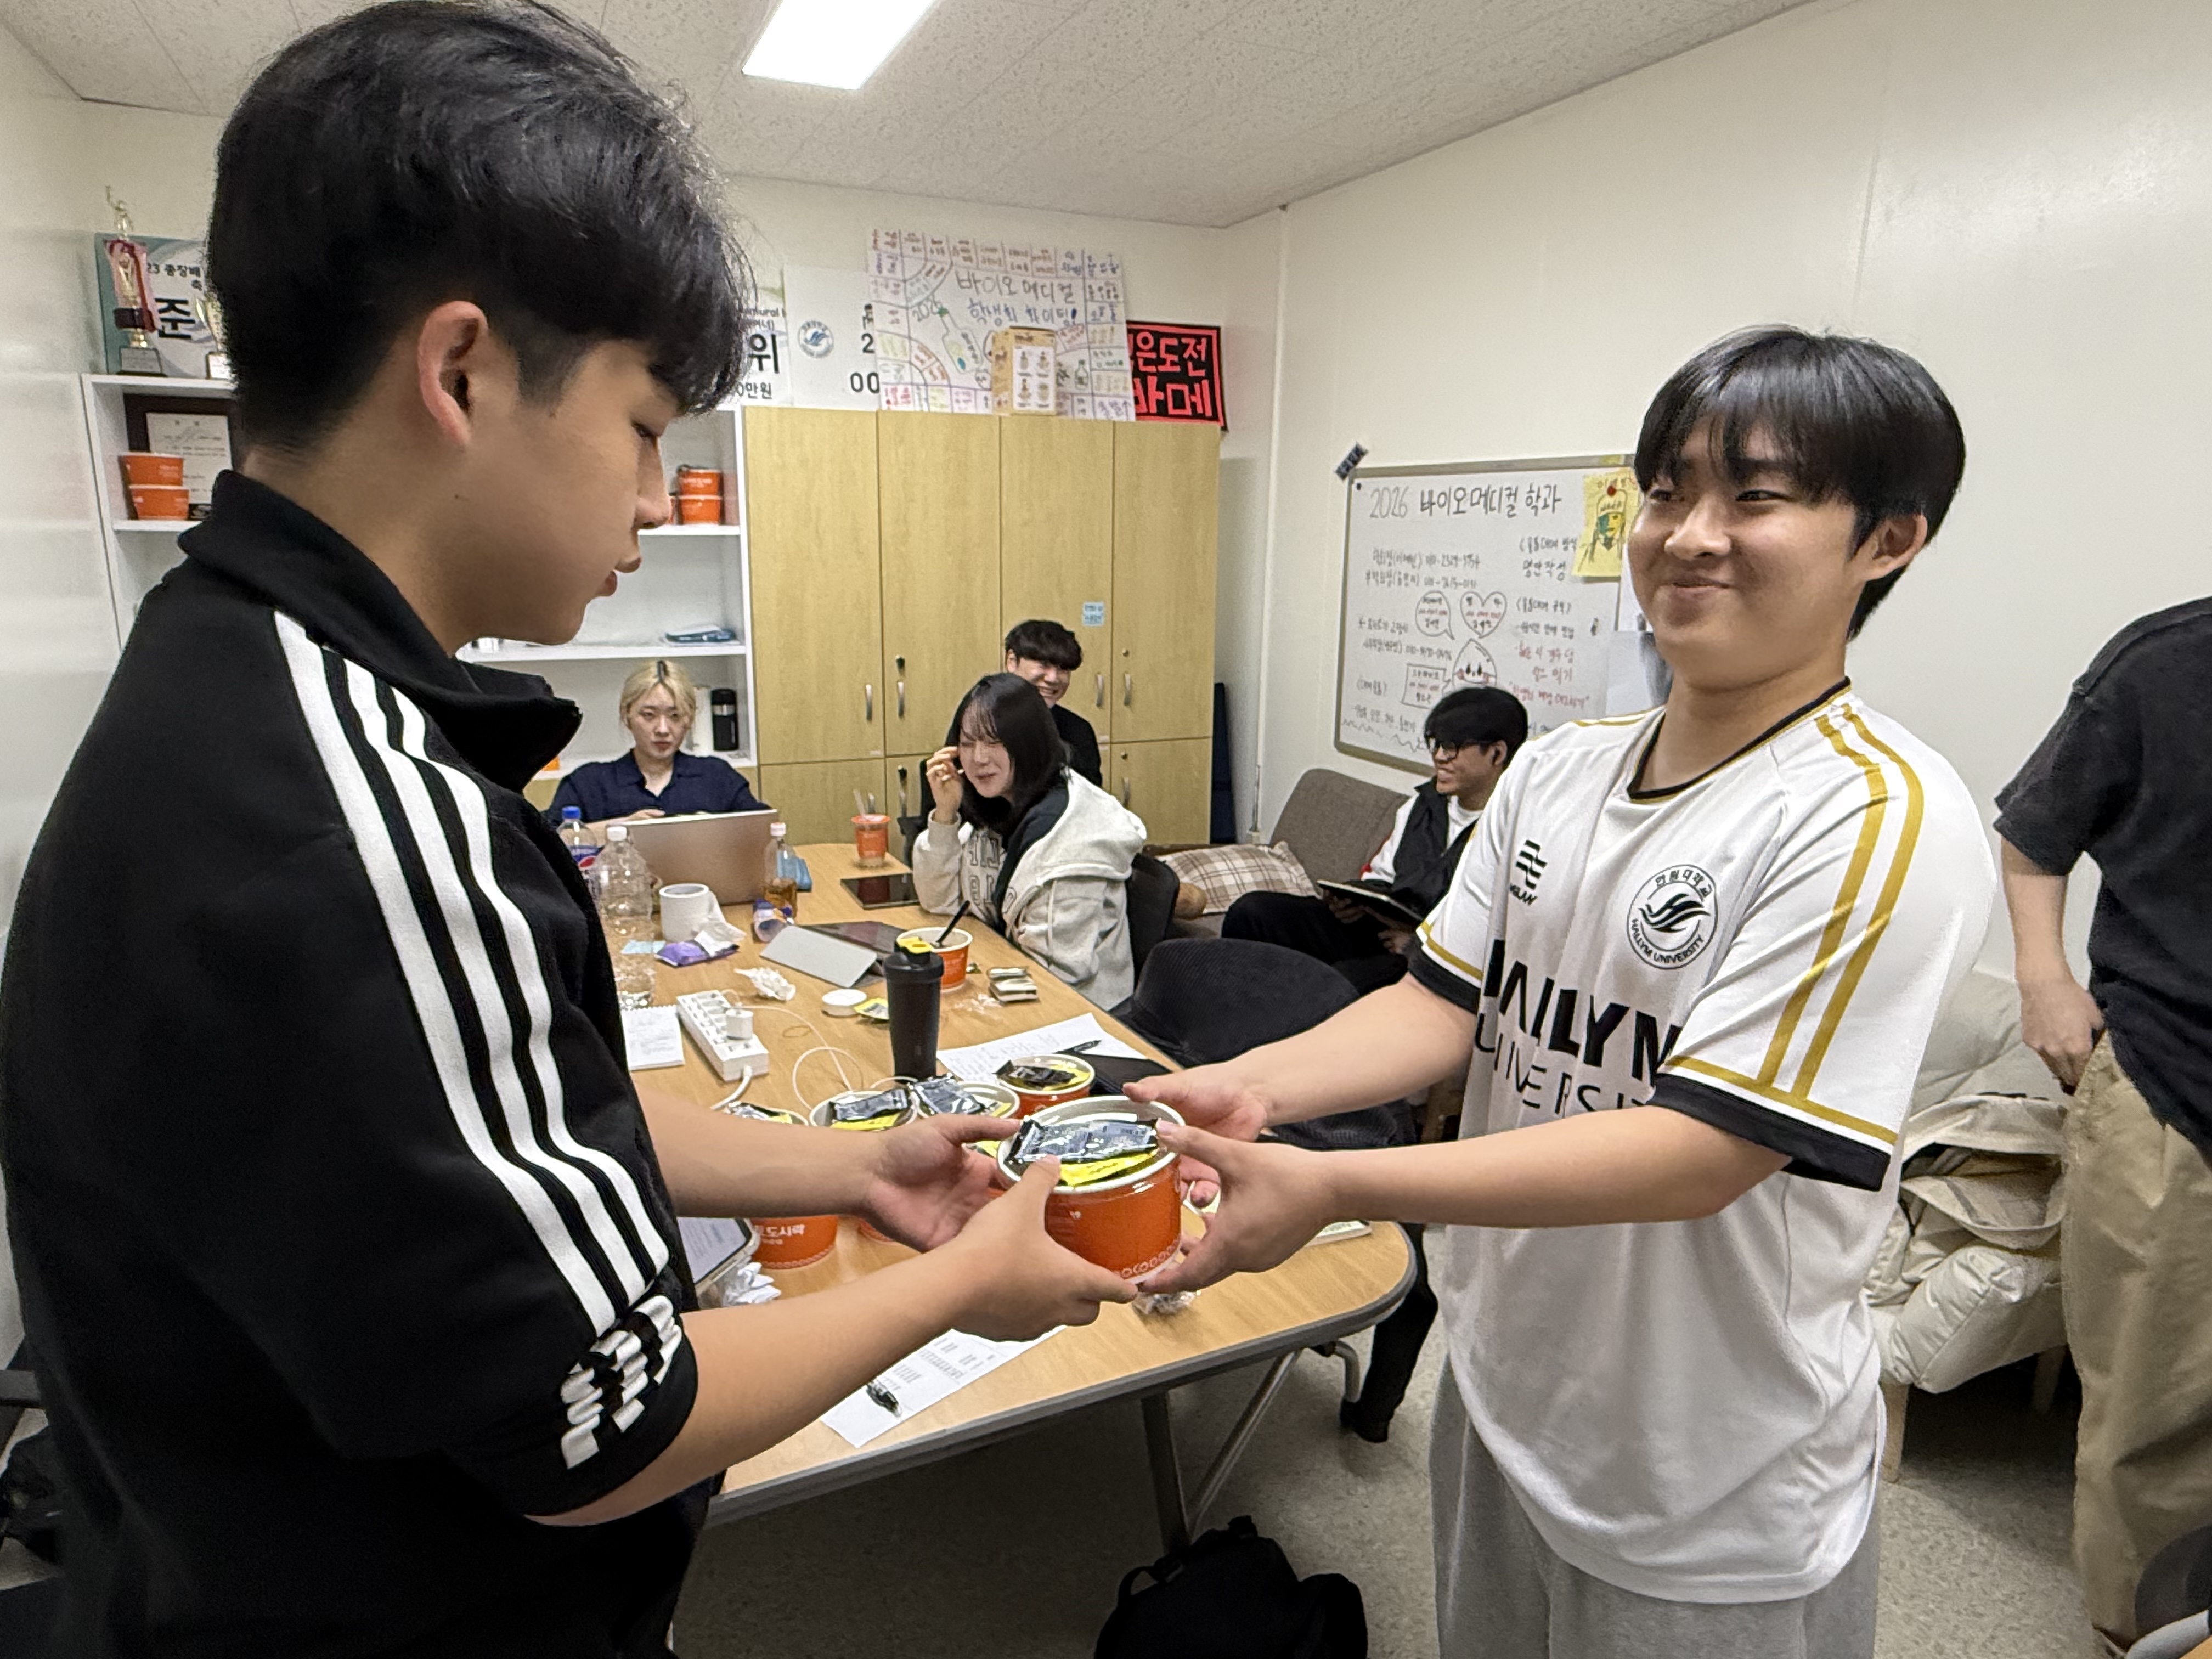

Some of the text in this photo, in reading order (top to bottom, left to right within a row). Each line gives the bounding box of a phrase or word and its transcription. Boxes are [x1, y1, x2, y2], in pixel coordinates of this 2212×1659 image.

[955, 270, 1018, 296] 바이오
[155, 298, 195, 340] 준
[747, 334, 780, 374] 위
[1128, 331, 1207, 376] 은도전
[1369, 483, 1561, 518] 2026 바이오메디컬 학과
[1654, 934, 1705, 964] UNIVERSITY
